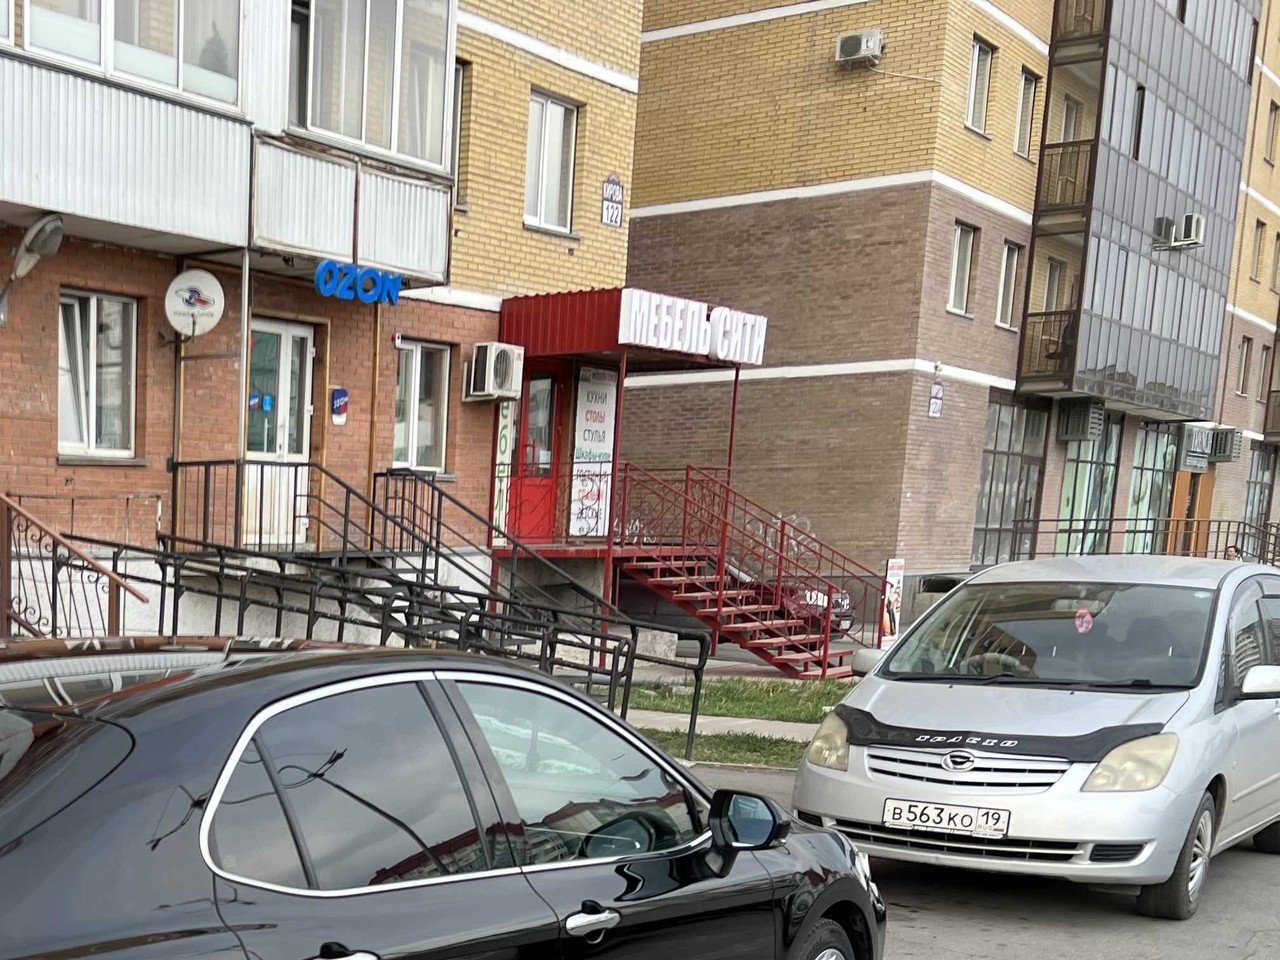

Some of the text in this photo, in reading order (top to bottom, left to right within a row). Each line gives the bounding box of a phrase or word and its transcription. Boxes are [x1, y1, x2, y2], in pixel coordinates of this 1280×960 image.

[606, 203, 620, 224] 122
[314, 260, 402, 305] OZON
[628, 290, 767, 365] МЕБЕЛЬ СИТИ
[586, 391, 608, 405] КУХНИ
[585, 409, 606, 424] СТОЛЫ
[583, 429, 606, 443] СТУЛЬЯ
